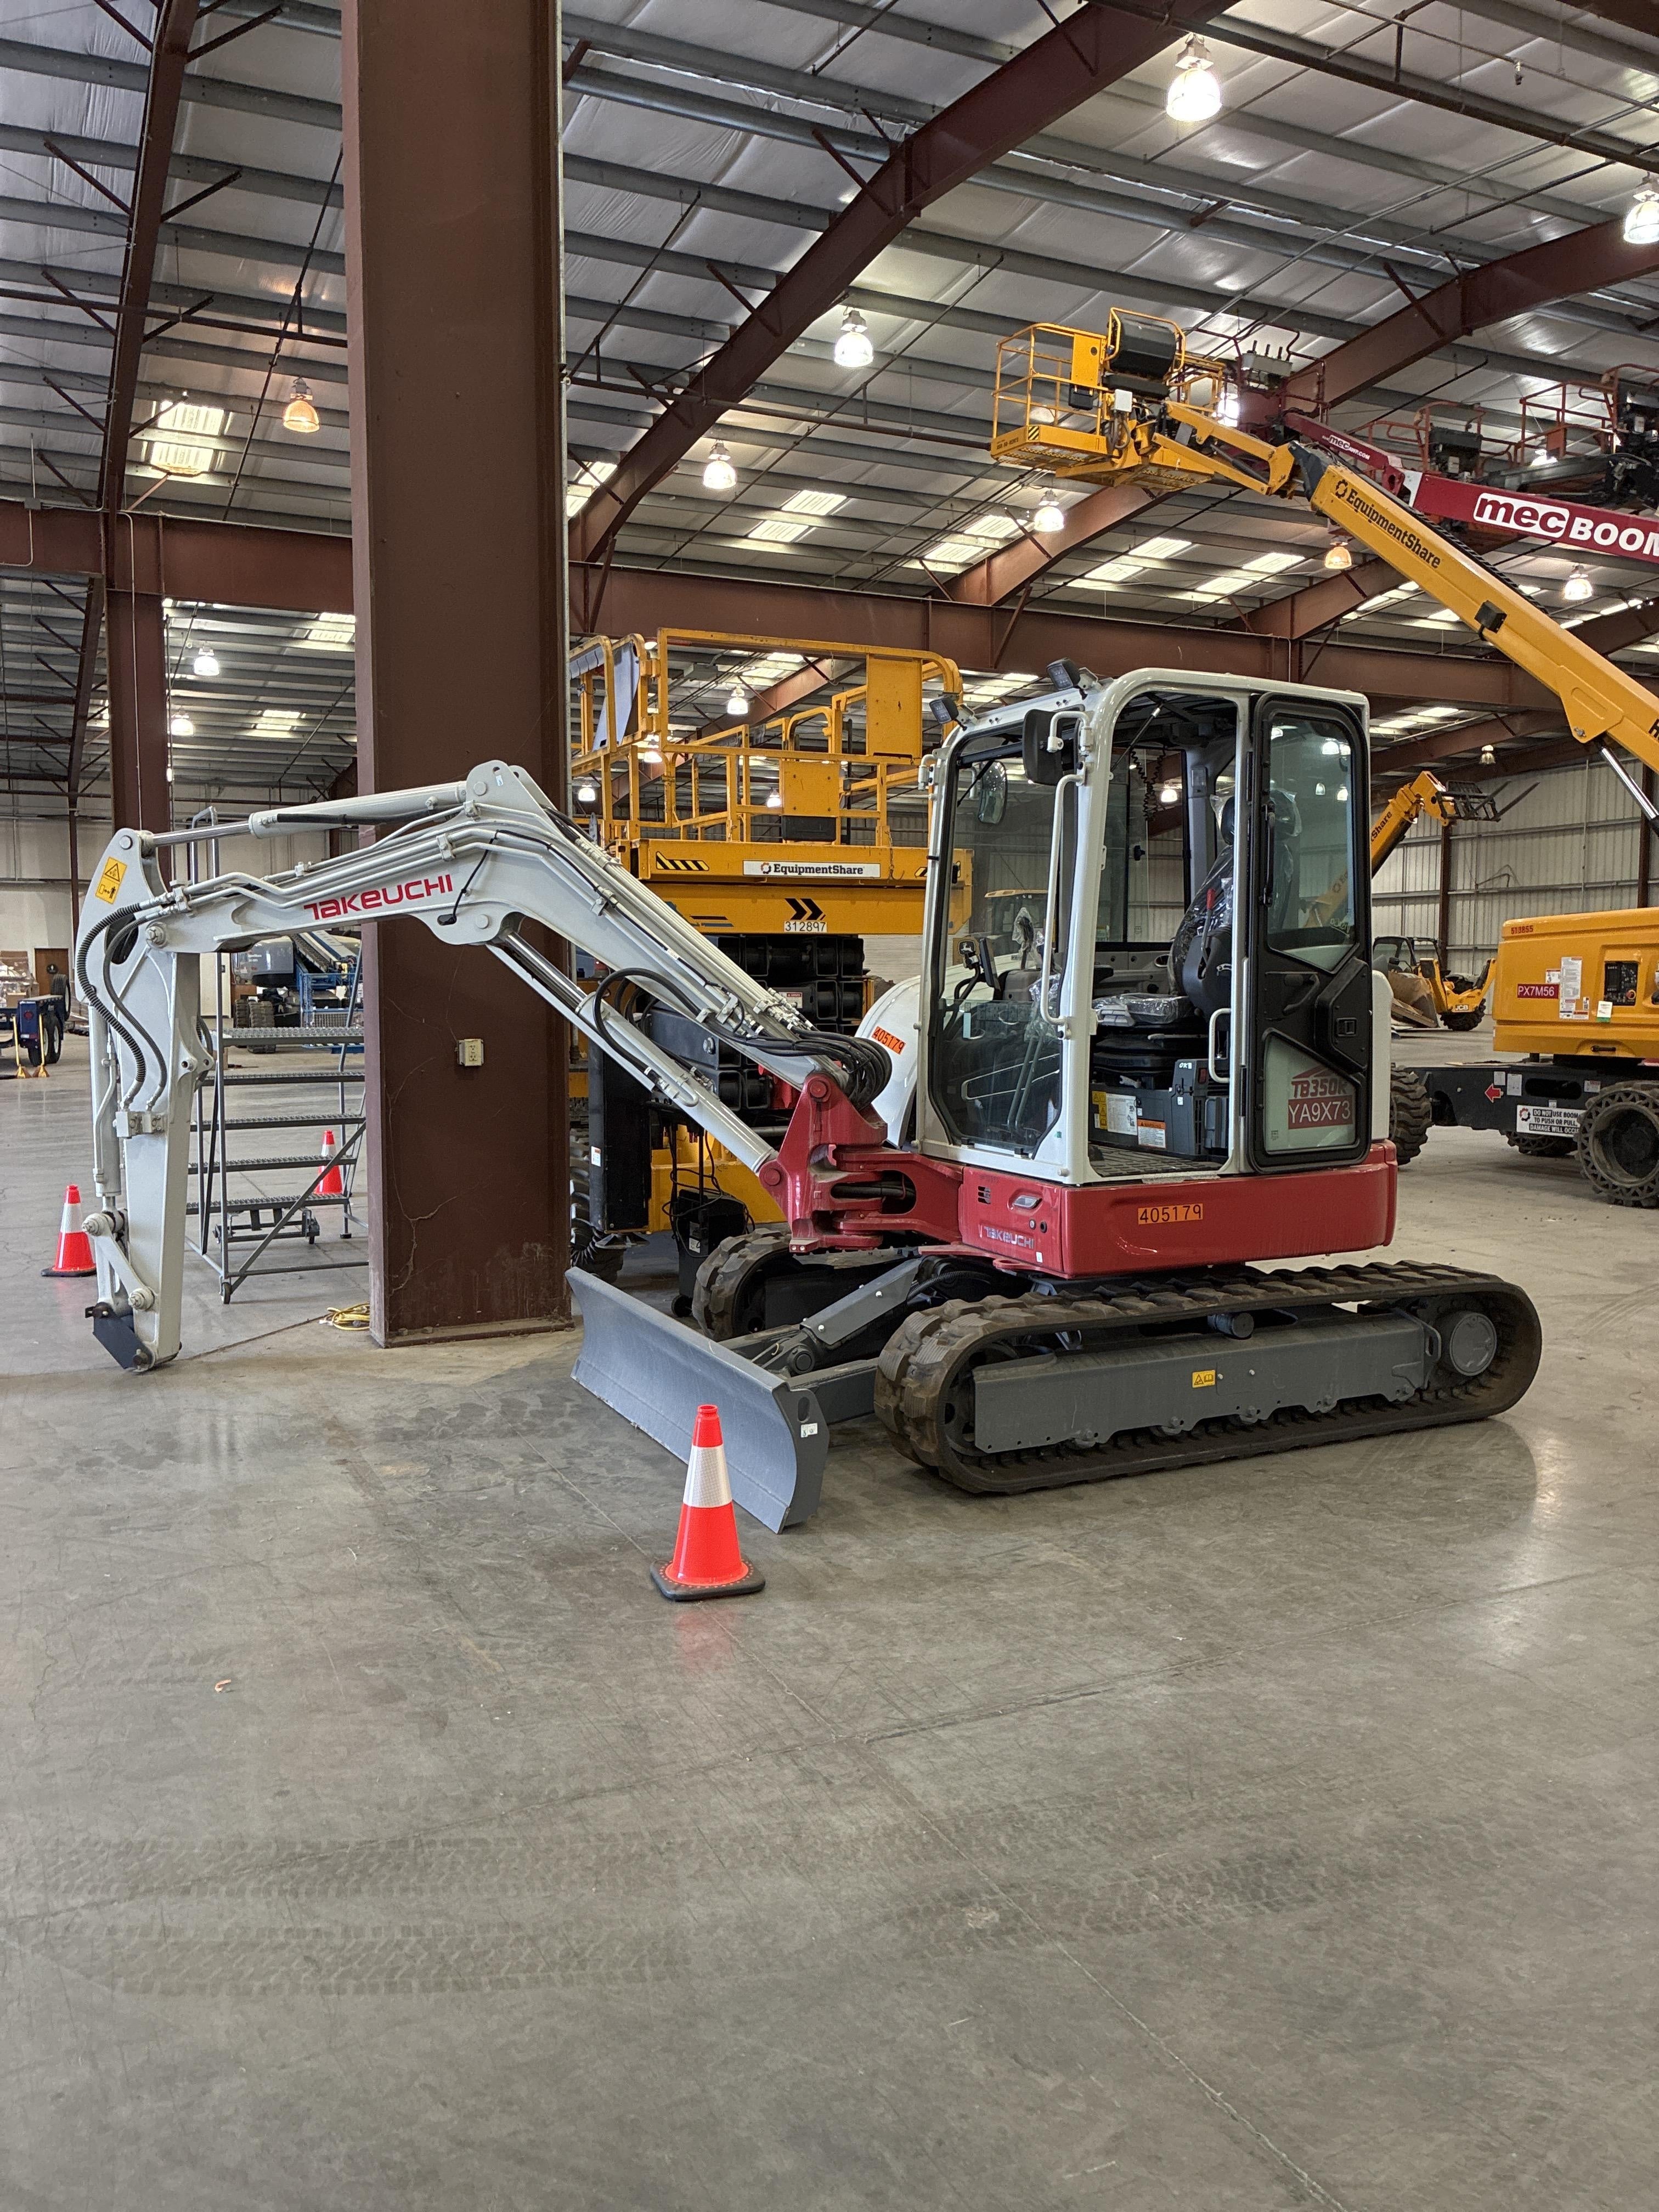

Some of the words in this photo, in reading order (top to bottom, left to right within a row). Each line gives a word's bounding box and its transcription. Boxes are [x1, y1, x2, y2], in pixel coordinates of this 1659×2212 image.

[1346, 488, 1441, 569] EquipmentShare
[774, 864, 864, 875] EquipmentShare
[304, 874, 453, 921] TAKEUCHI
[785, 921, 826, 932] 312897
[1518, 986, 1555, 996] PX7M56
[873, 1028, 905, 1054] 405179
[1291, 1077, 1348, 1099] TB350R
[1289, 1100, 1351, 1124] YA9X73
[1140, 1204, 1201, 1223] 405179
[984, 1226, 1034, 1249] TAKEUCHI
